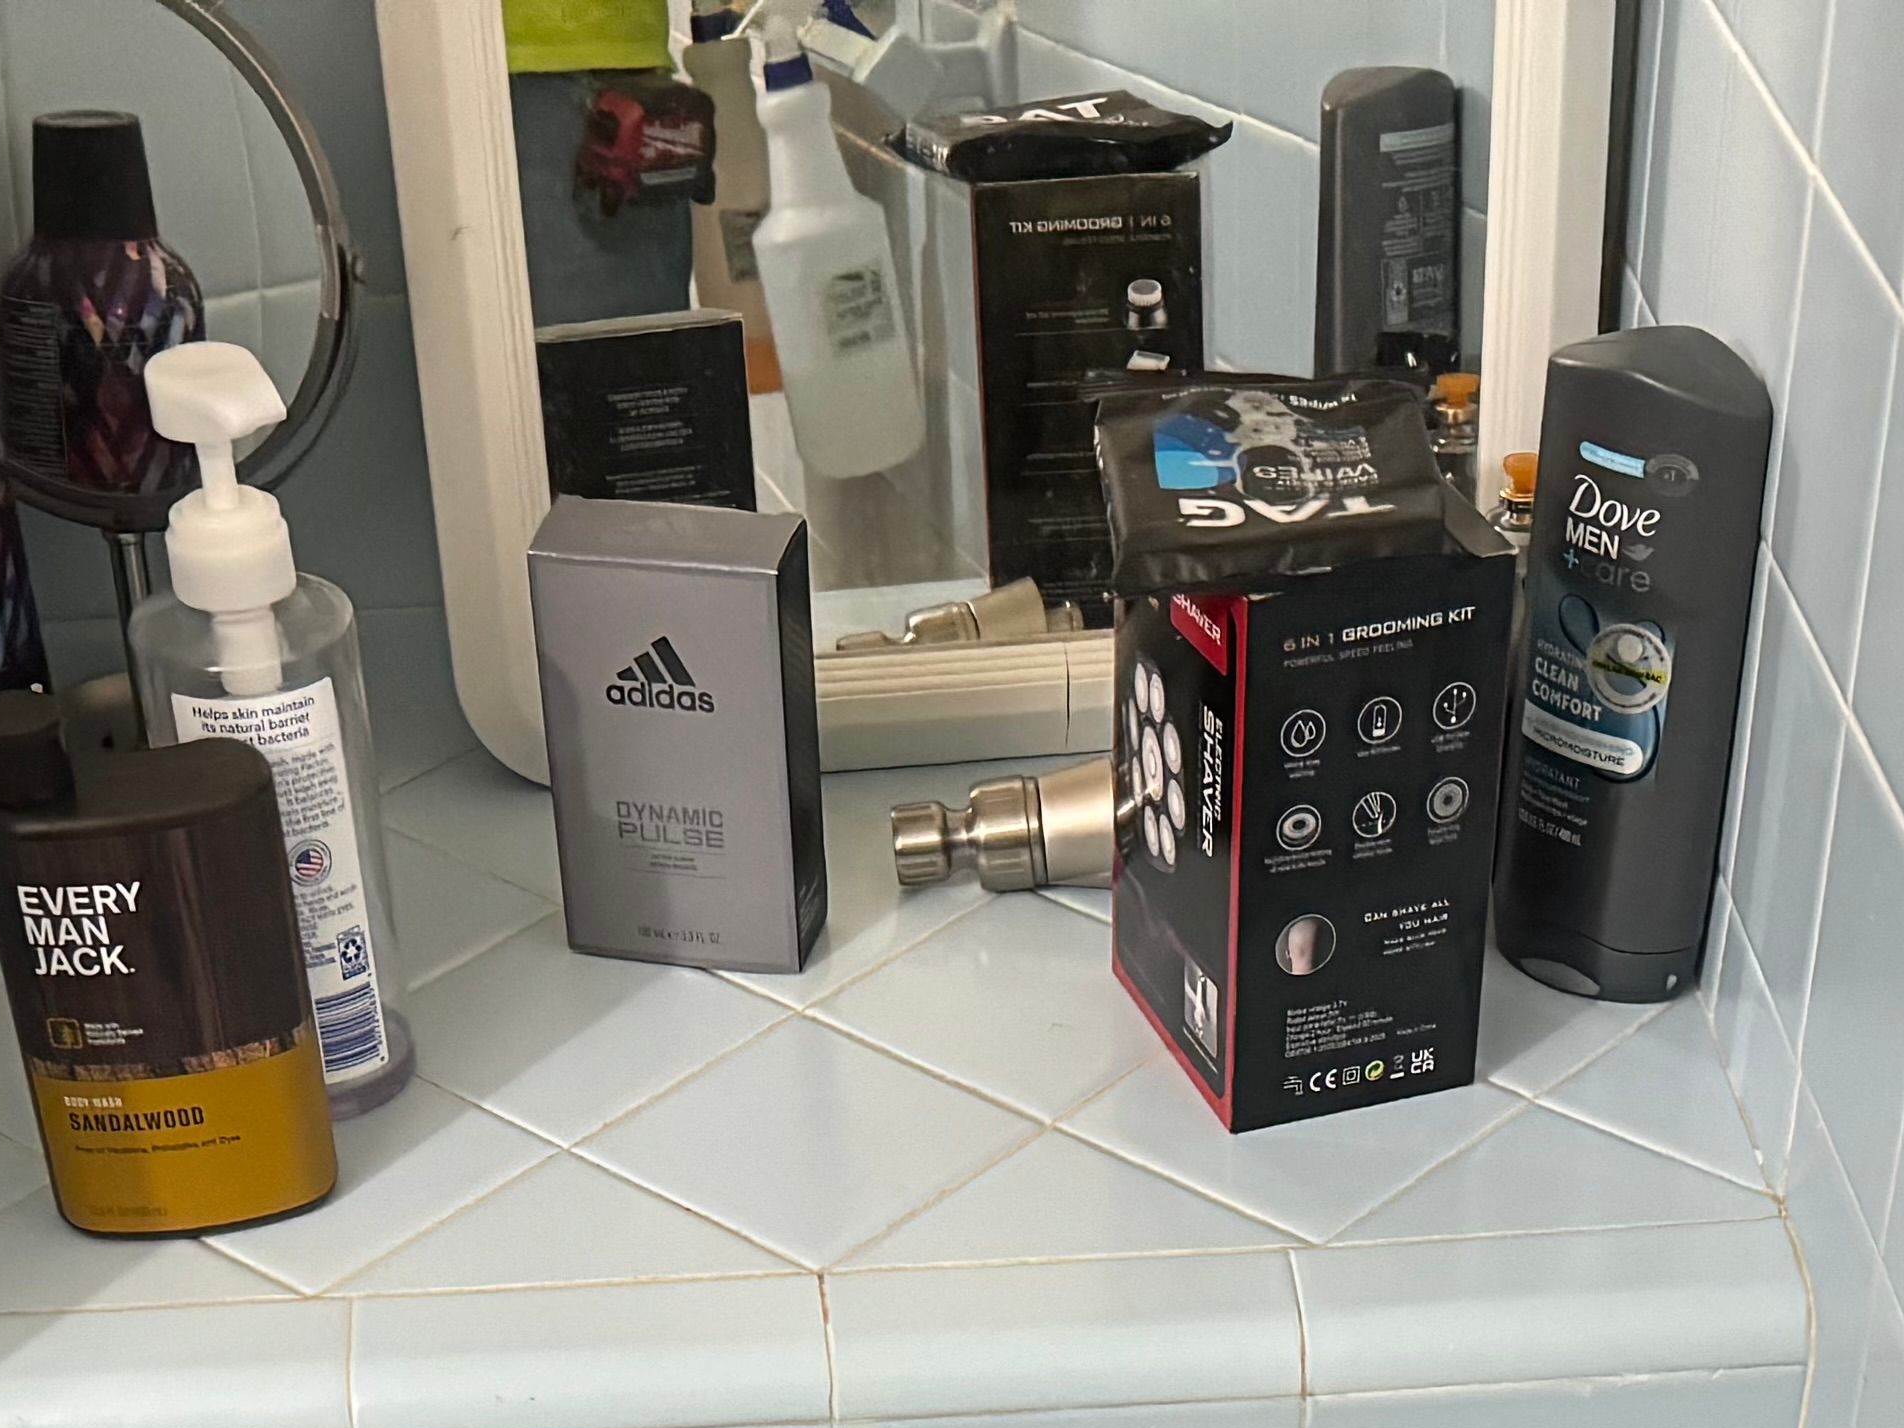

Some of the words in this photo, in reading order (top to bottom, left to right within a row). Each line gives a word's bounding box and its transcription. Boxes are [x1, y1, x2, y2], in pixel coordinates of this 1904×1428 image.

[1178, 496, 1397, 528] TAG
[1569, 474, 1661, 537] Dove
[1565, 516, 1619, 560] MEN
[1283, 638, 1296, 652] 6
[1301, 634, 1320, 649] IN
[1342, 612, 1444, 642] GROOMING
[1448, 606, 1476, 624] KIT
[1535, 656, 1580, 693] CLEAN
[192, 706, 229, 721] Helps
[232, 708, 258, 720] skin
[261, 696, 315, 717] maintain
[605, 681, 715, 713] adidas
[1532, 678, 1603, 722] COMFORT
[201, 721, 216, 733] its
[220, 720, 265, 733] natural
[269, 712, 310, 731] barrier
[258, 727, 309, 746] bacteria
[1202, 705, 1215, 858] SHAVER
[1214, 717, 1223, 821] ELECTRIC
[616, 800, 724, 829] DYNAMIC
[618, 820, 725, 849] PULSE
[17, 881, 140, 916] EVERY
[23, 915, 110, 946] MAN
[35, 945, 136, 976] JACK.
[1410, 1059, 1435, 1075] CA
[1411, 1047, 1435, 1063] UK
[69, 1106, 204, 1132] SANDALWOOD
